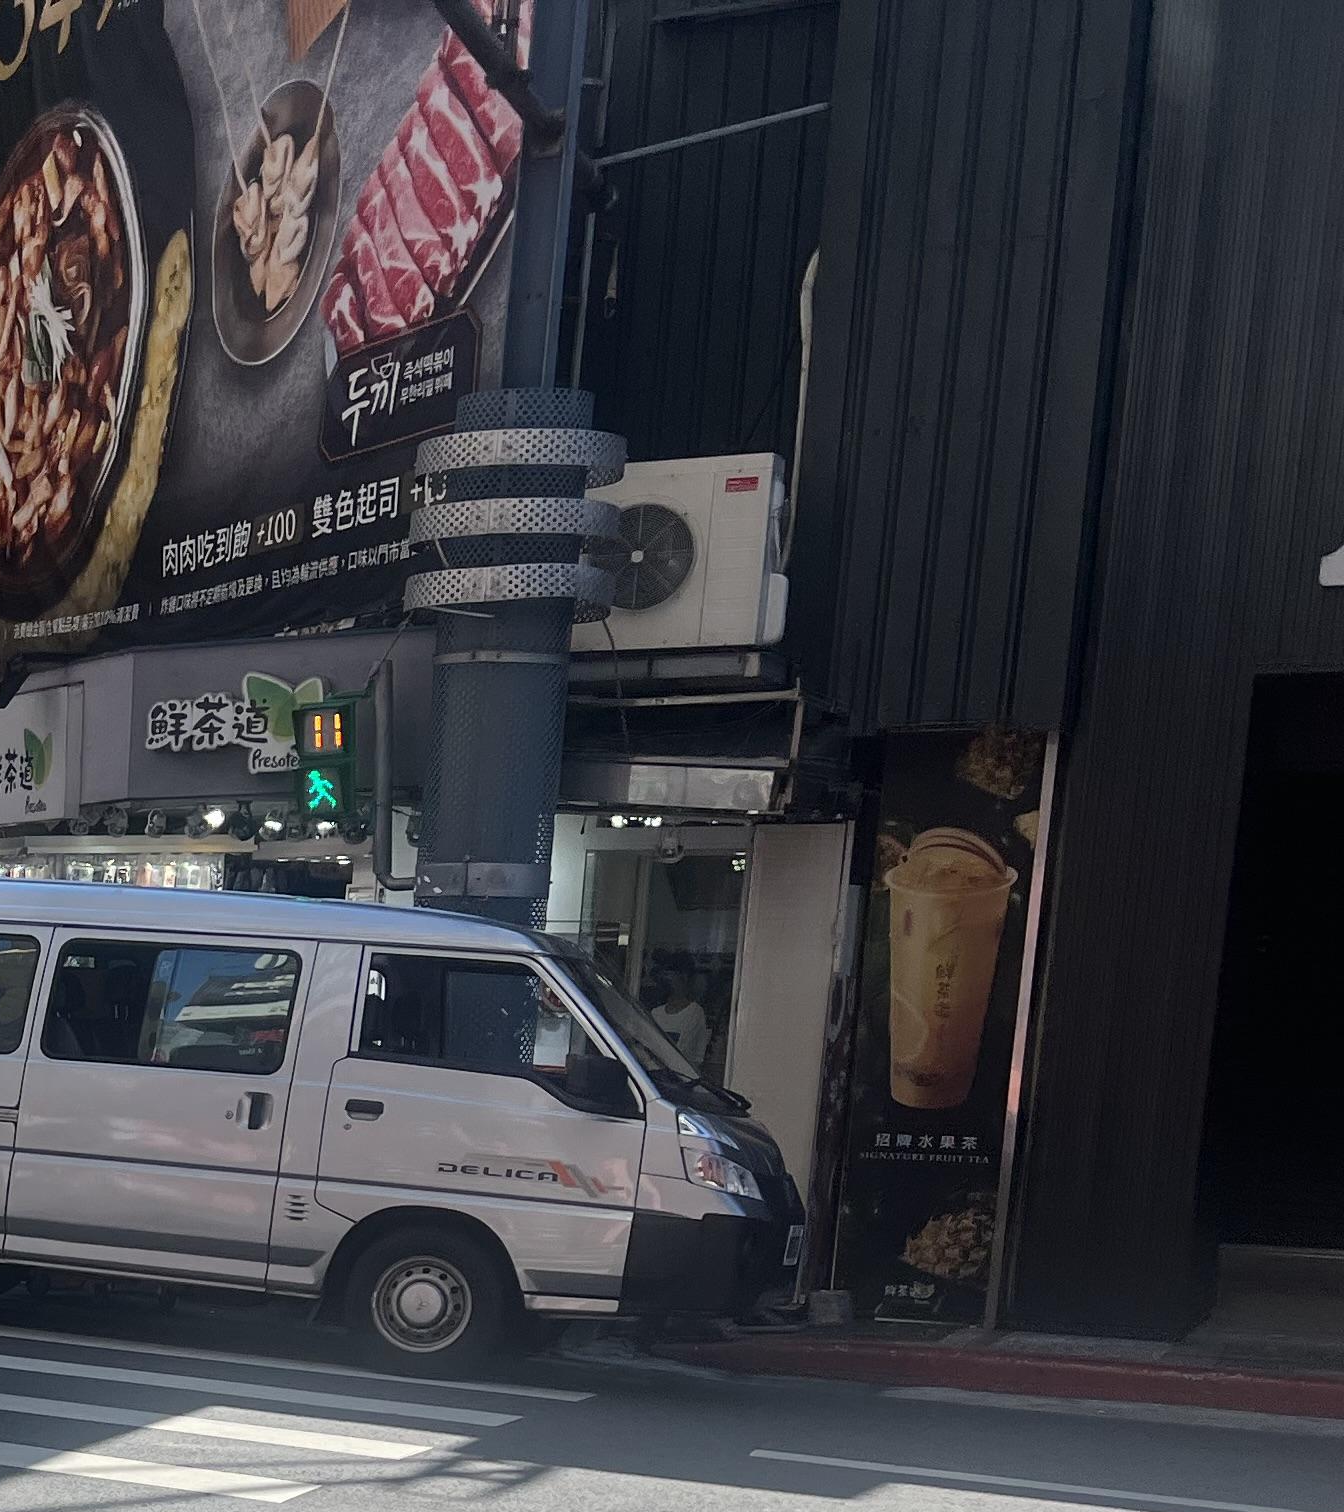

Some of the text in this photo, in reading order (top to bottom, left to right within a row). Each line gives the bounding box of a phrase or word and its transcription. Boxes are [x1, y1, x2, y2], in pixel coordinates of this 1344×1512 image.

[161, 518, 253, 579] 肉肉吃到飽
[256, 508, 297, 547] +100
[311, 475, 401, 539] 雙色起司
[148, 696, 269, 746] 鮮茶道
[314, 712, 342, 749] 11
[252, 748, 300, 770] Presote
[874, 1132, 978, 1150] 招牌水果茶
[860, 1151, 990, 1164] SIGNATURE FRUIT TEA
[438, 1162, 559, 1182] DELICA
